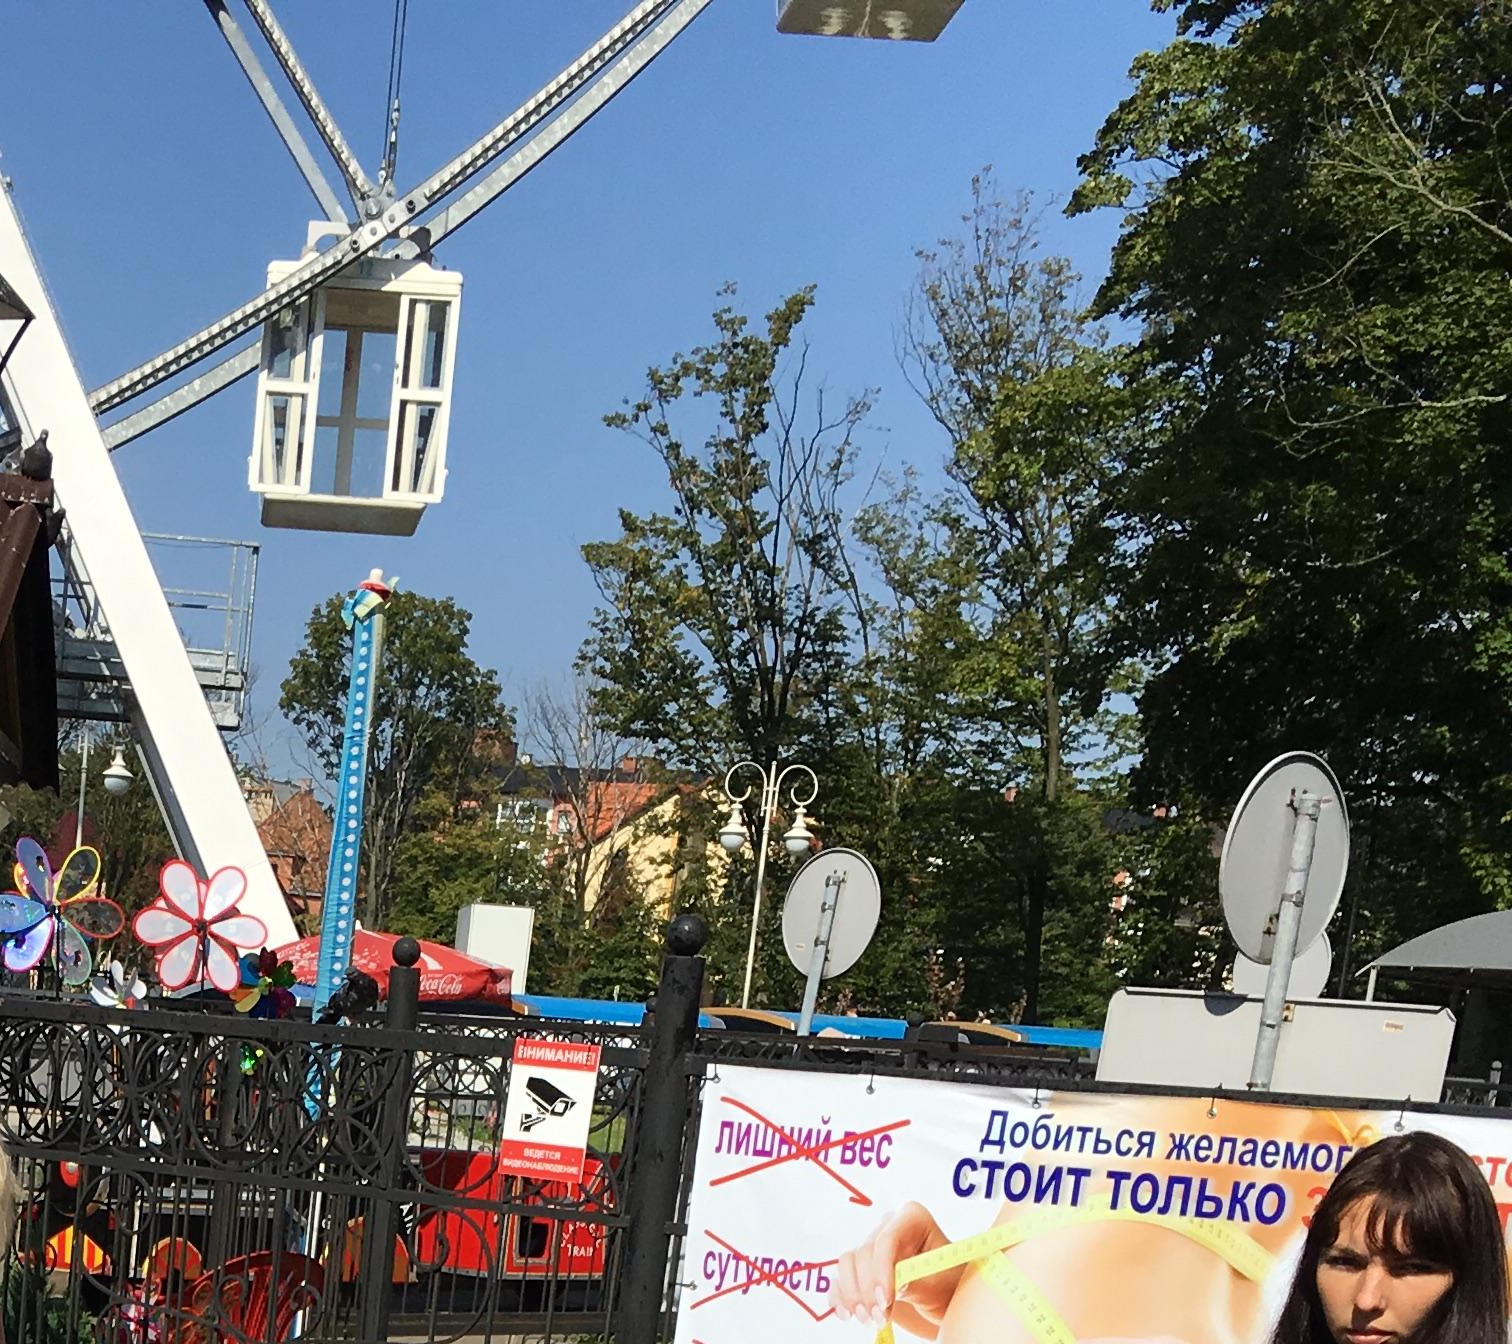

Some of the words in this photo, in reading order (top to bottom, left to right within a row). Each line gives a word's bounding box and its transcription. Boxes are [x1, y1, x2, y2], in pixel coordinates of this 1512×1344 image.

[839, 1130, 893, 1168] вес
[979, 1109, 1157, 1158] Добиться
[1164, 1131, 1354, 1174] желаемог
[952, 1157, 1092, 1207] СТОИТ
[1106, 1170, 1286, 1225] ТОЛЬКО
